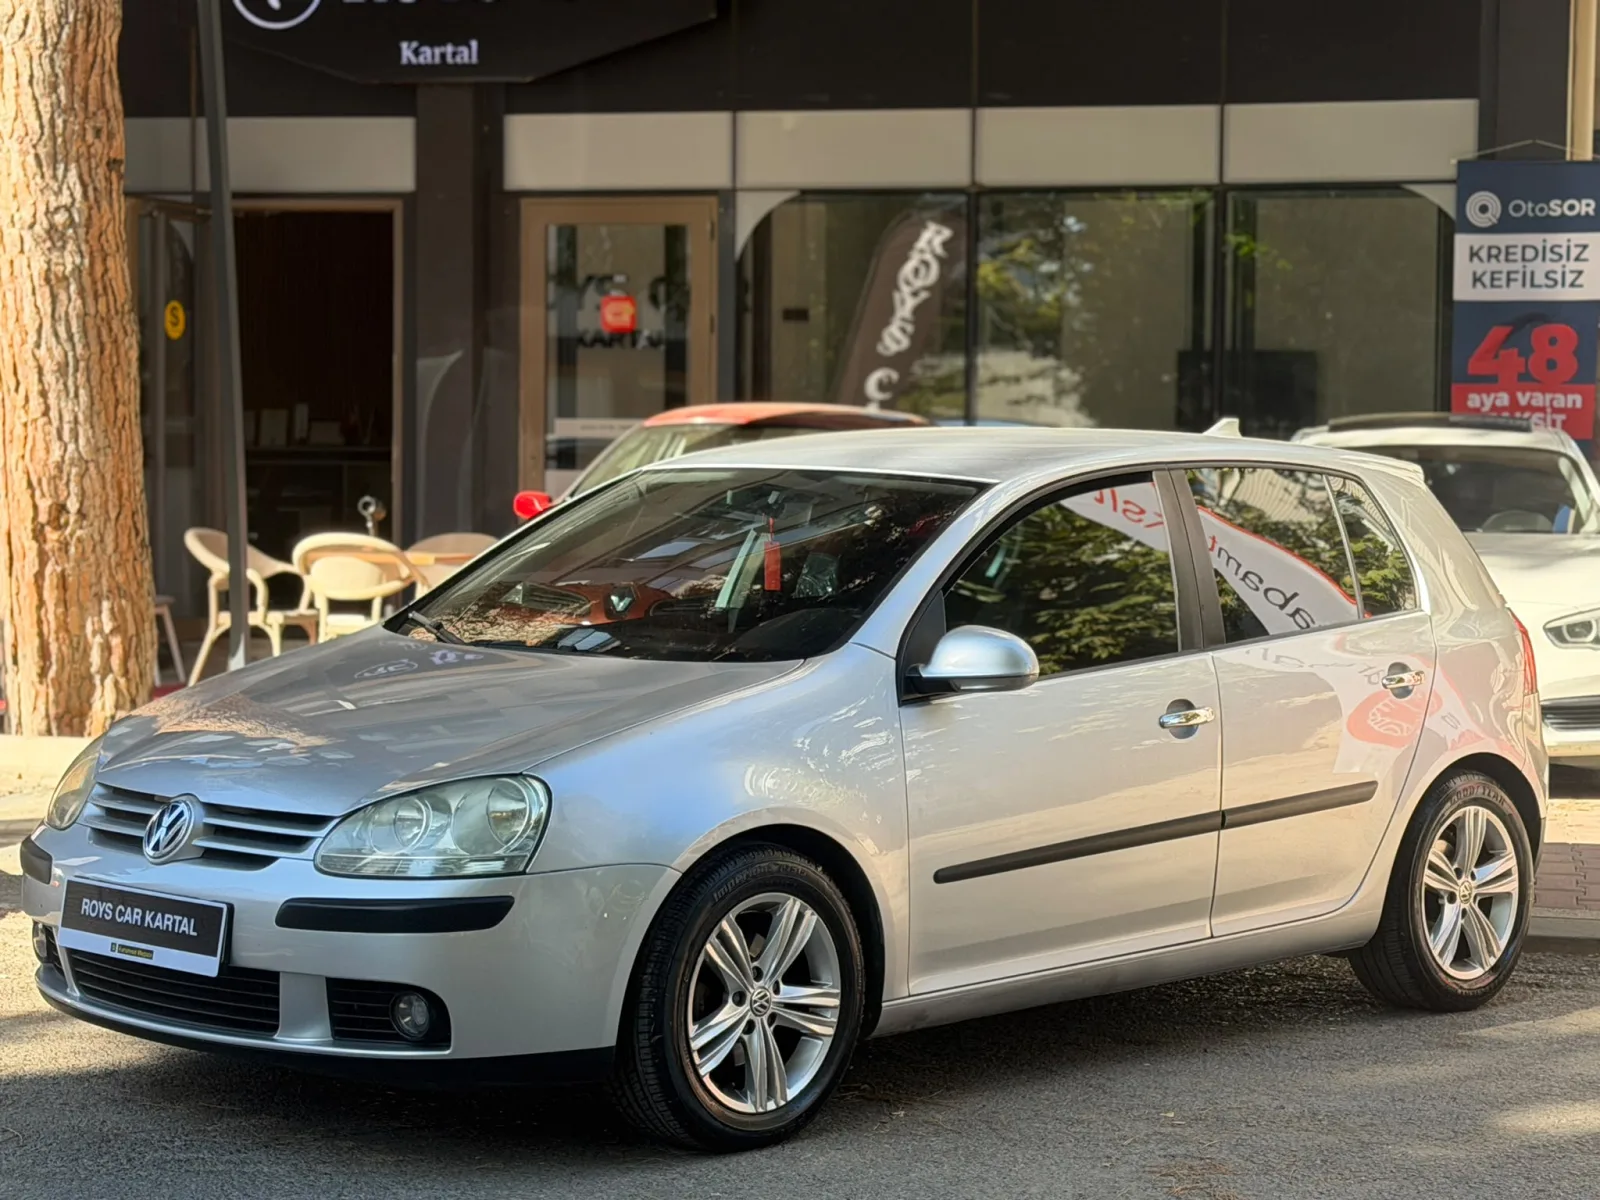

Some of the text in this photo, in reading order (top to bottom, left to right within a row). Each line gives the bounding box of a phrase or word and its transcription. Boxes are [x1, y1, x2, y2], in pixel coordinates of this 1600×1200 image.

[399, 39, 478, 65] Kartal
[1508, 198, 1596, 219] OtoSOR
[1468, 238, 1590, 264] KREDİSİZ
[1471, 264, 1585, 290] KEFİLSİZ
[1466, 323, 1579, 386] 48
[1466, 391, 1583, 412] aya varan
[81, 898, 198, 936] ROYS CAR KARTAL
